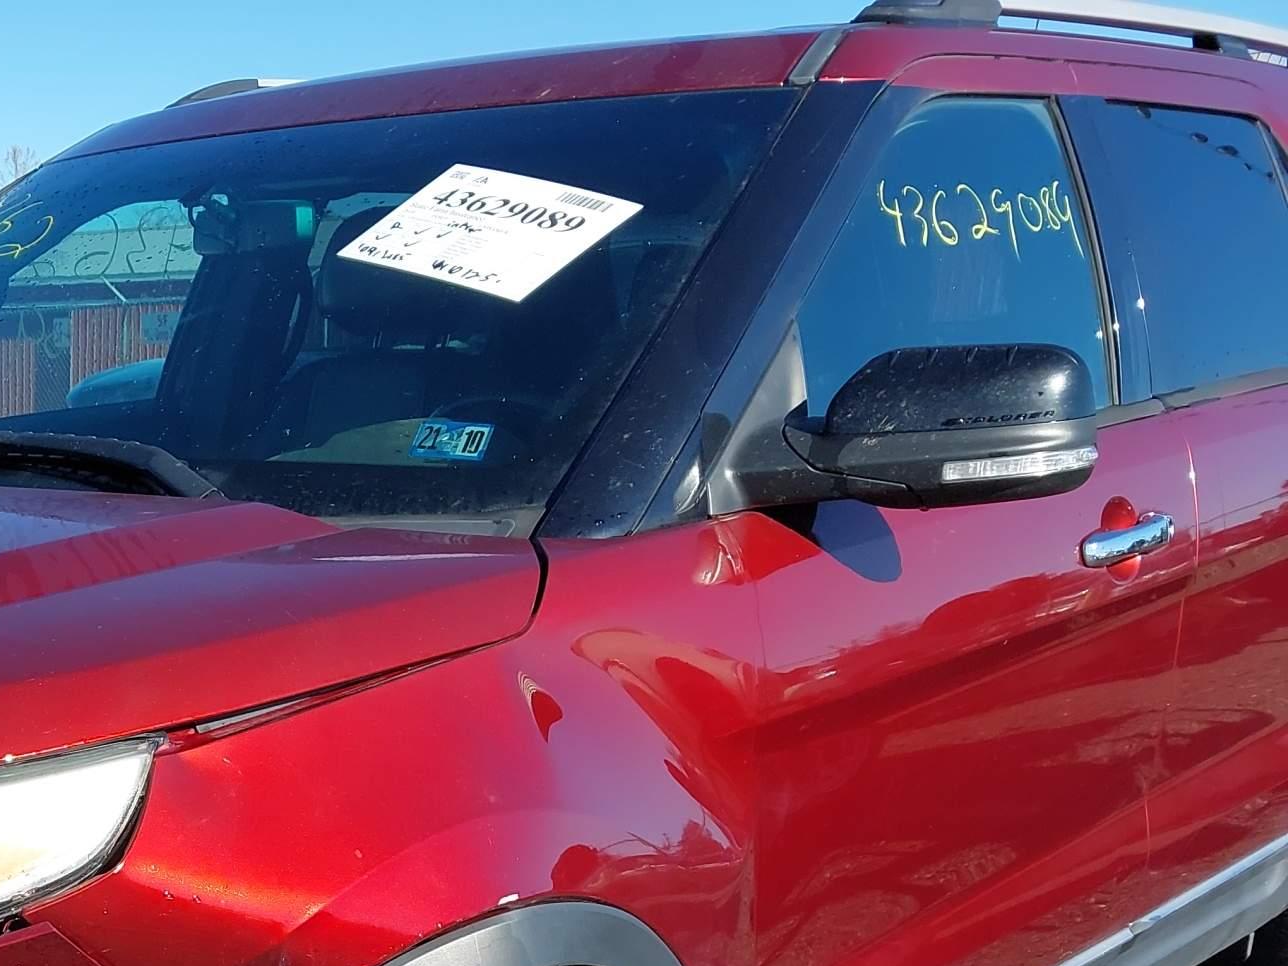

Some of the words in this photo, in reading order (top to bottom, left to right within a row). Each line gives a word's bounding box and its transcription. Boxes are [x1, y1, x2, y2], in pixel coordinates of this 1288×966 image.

[432, 188, 586, 233] 43629089
[876, 178, 1085, 263] 43629089
[417, 425, 443, 450] 21
[460, 429, 486, 454] 10
